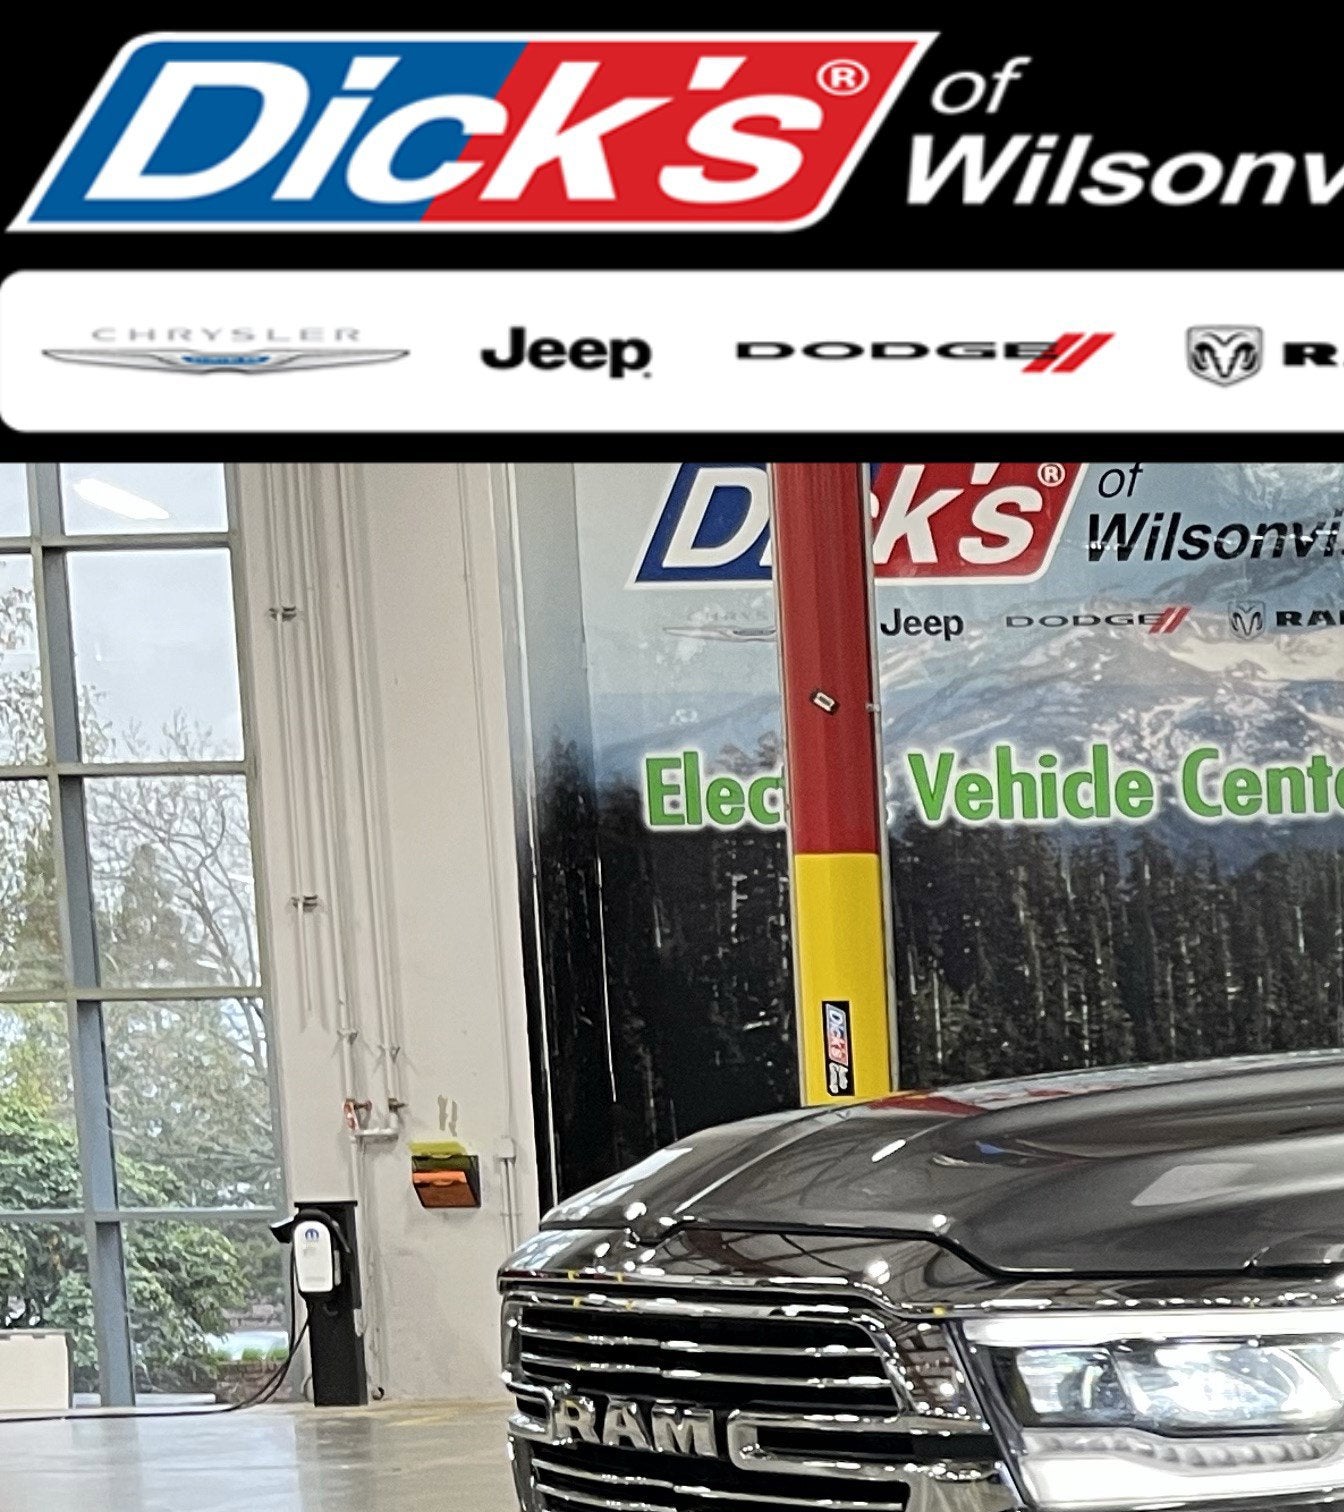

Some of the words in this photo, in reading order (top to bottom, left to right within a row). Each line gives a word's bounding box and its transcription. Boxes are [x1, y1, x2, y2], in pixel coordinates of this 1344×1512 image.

[662, 462, 1043, 566] Dk's
[1097, 462, 1144, 498] of
[880, 608, 964, 641] Jeep
[1006, 612, 1162, 628] DODGE
[907, 744, 1154, 822] Vehicle
[552, 1396, 719, 1459] RAM
